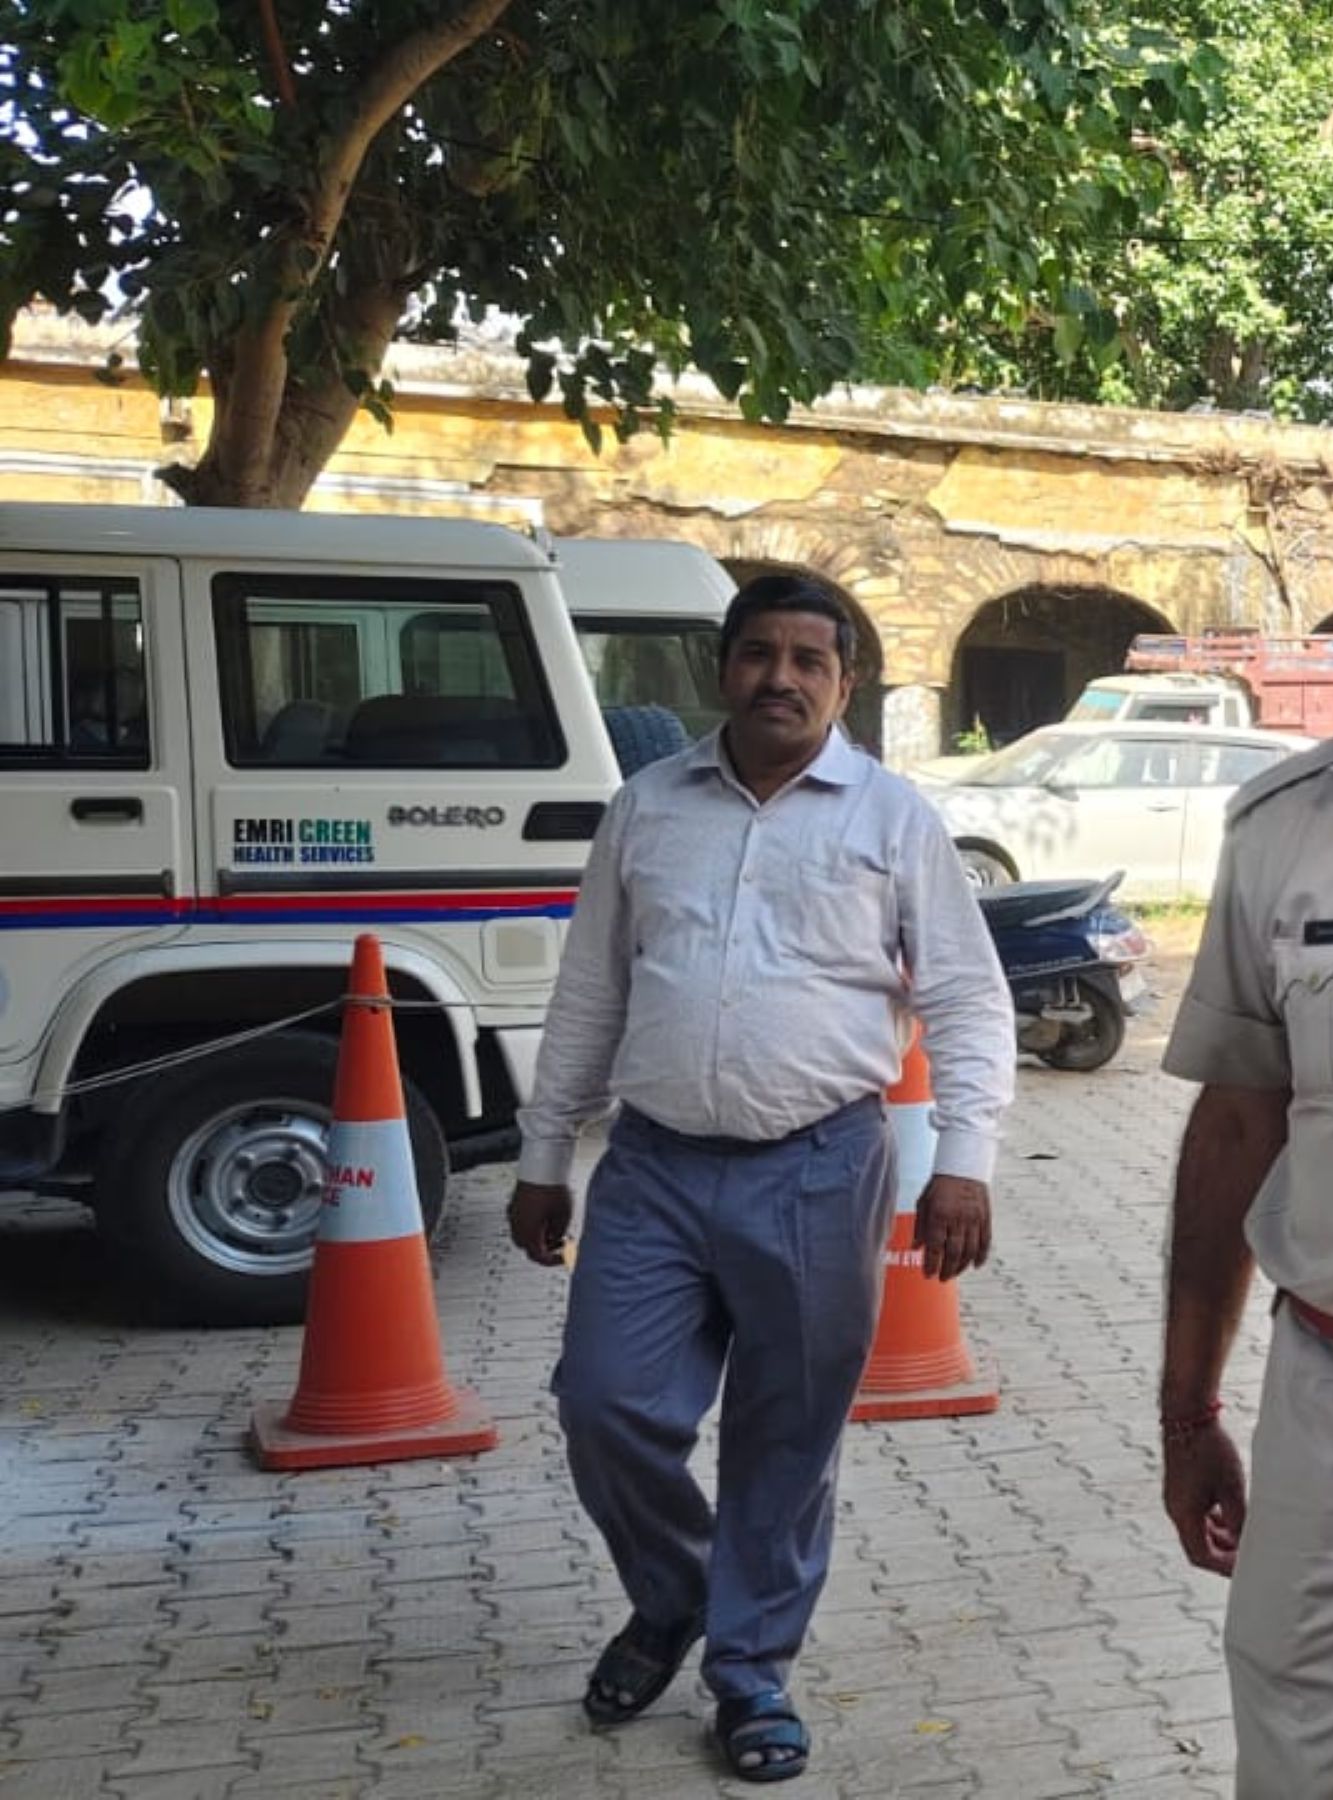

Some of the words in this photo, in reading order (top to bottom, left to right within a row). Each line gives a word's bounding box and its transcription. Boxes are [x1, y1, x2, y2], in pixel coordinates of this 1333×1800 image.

[387, 805, 506, 829] BOLERO
[233, 818, 293, 843] EMRI
[299, 818, 371, 844] GREEN
[233, 846, 294, 863] HEALTH
[299, 846, 375, 863] SERVICES
